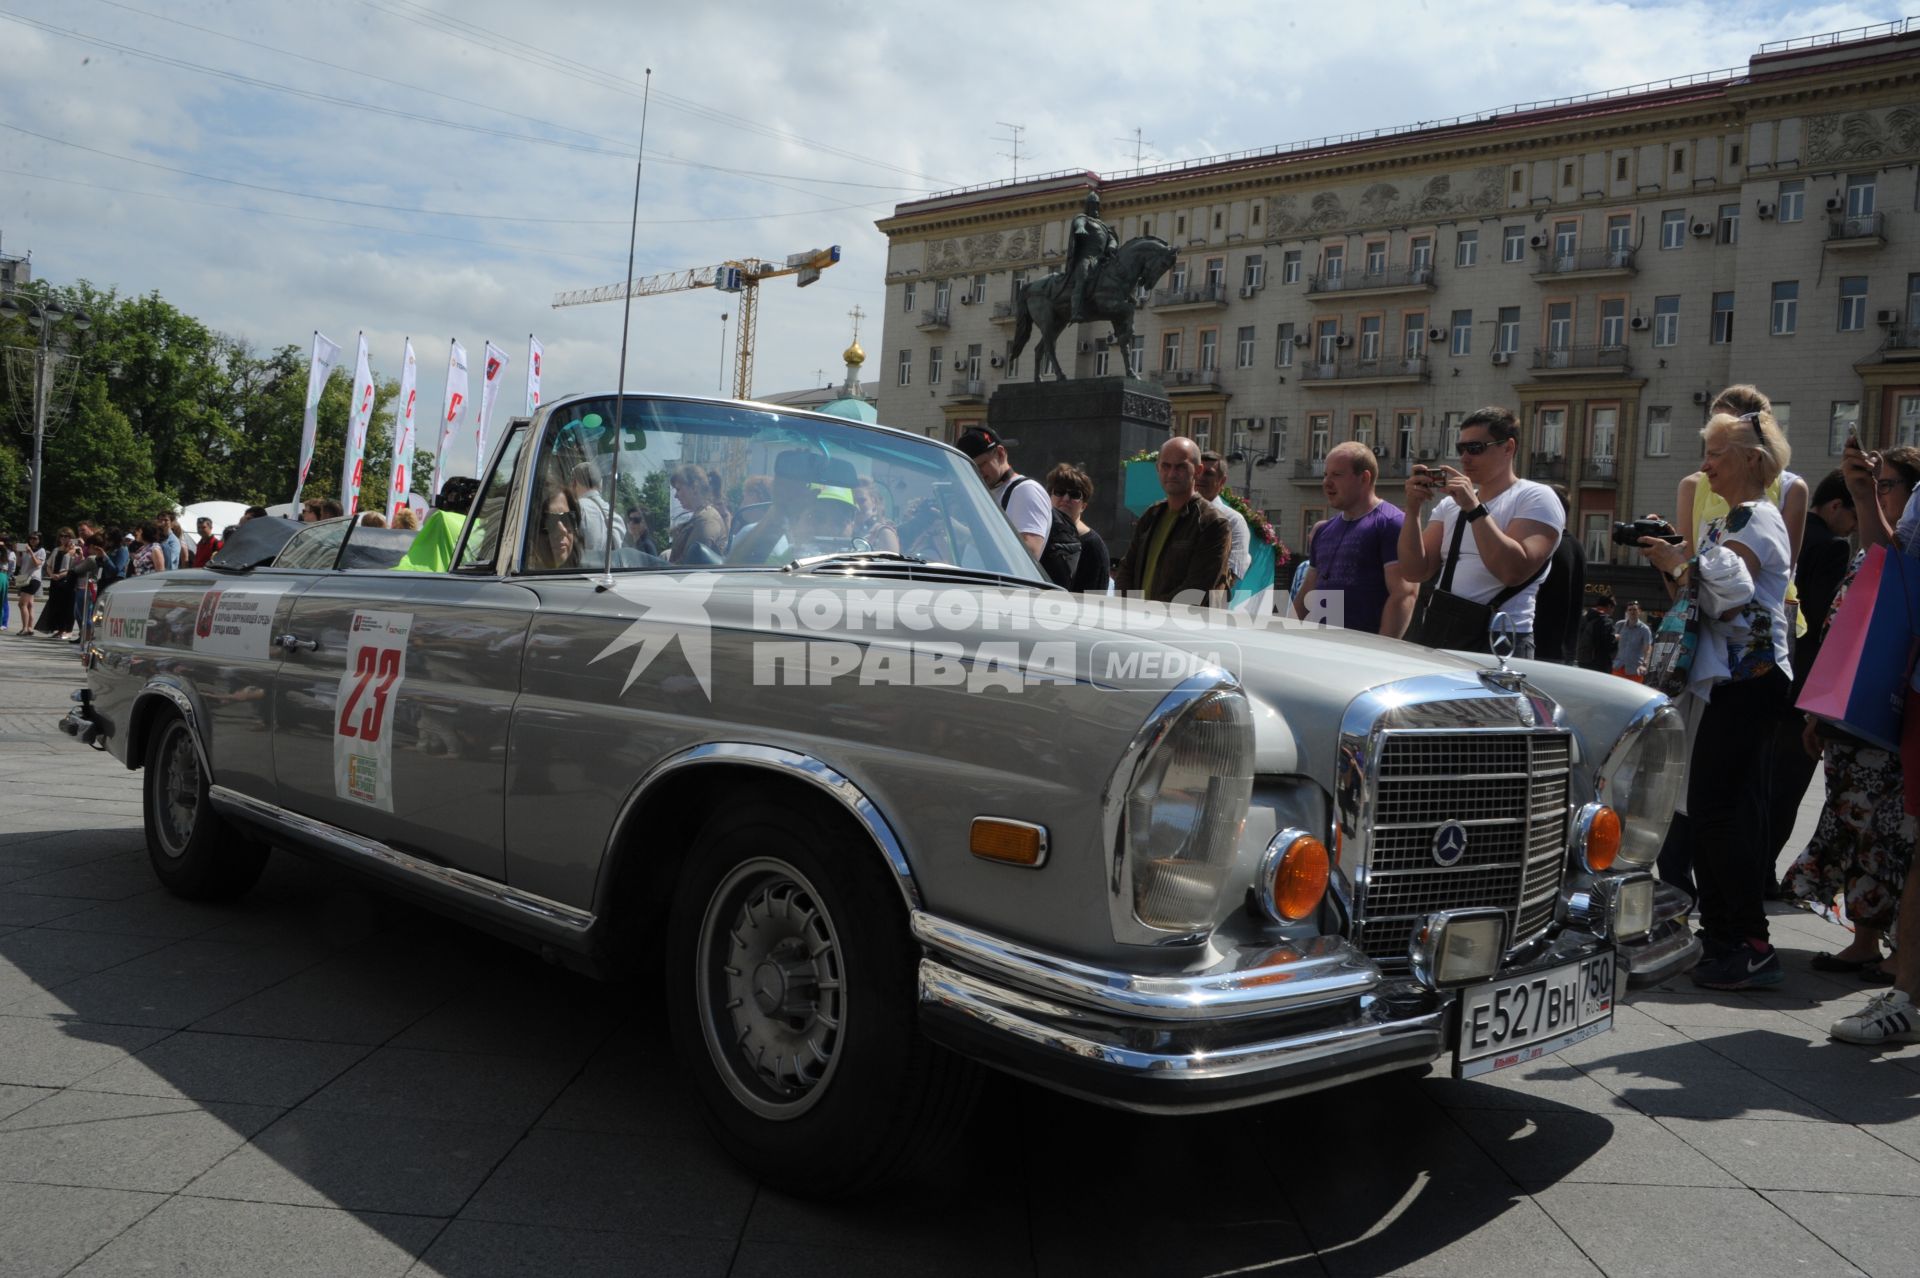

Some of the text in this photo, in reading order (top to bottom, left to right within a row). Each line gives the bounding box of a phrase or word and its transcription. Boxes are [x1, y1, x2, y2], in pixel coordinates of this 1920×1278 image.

[109, 617, 147, 641] TATNEFT
[338, 646, 401, 743] 23
[1581, 957, 1609, 1003] 750
